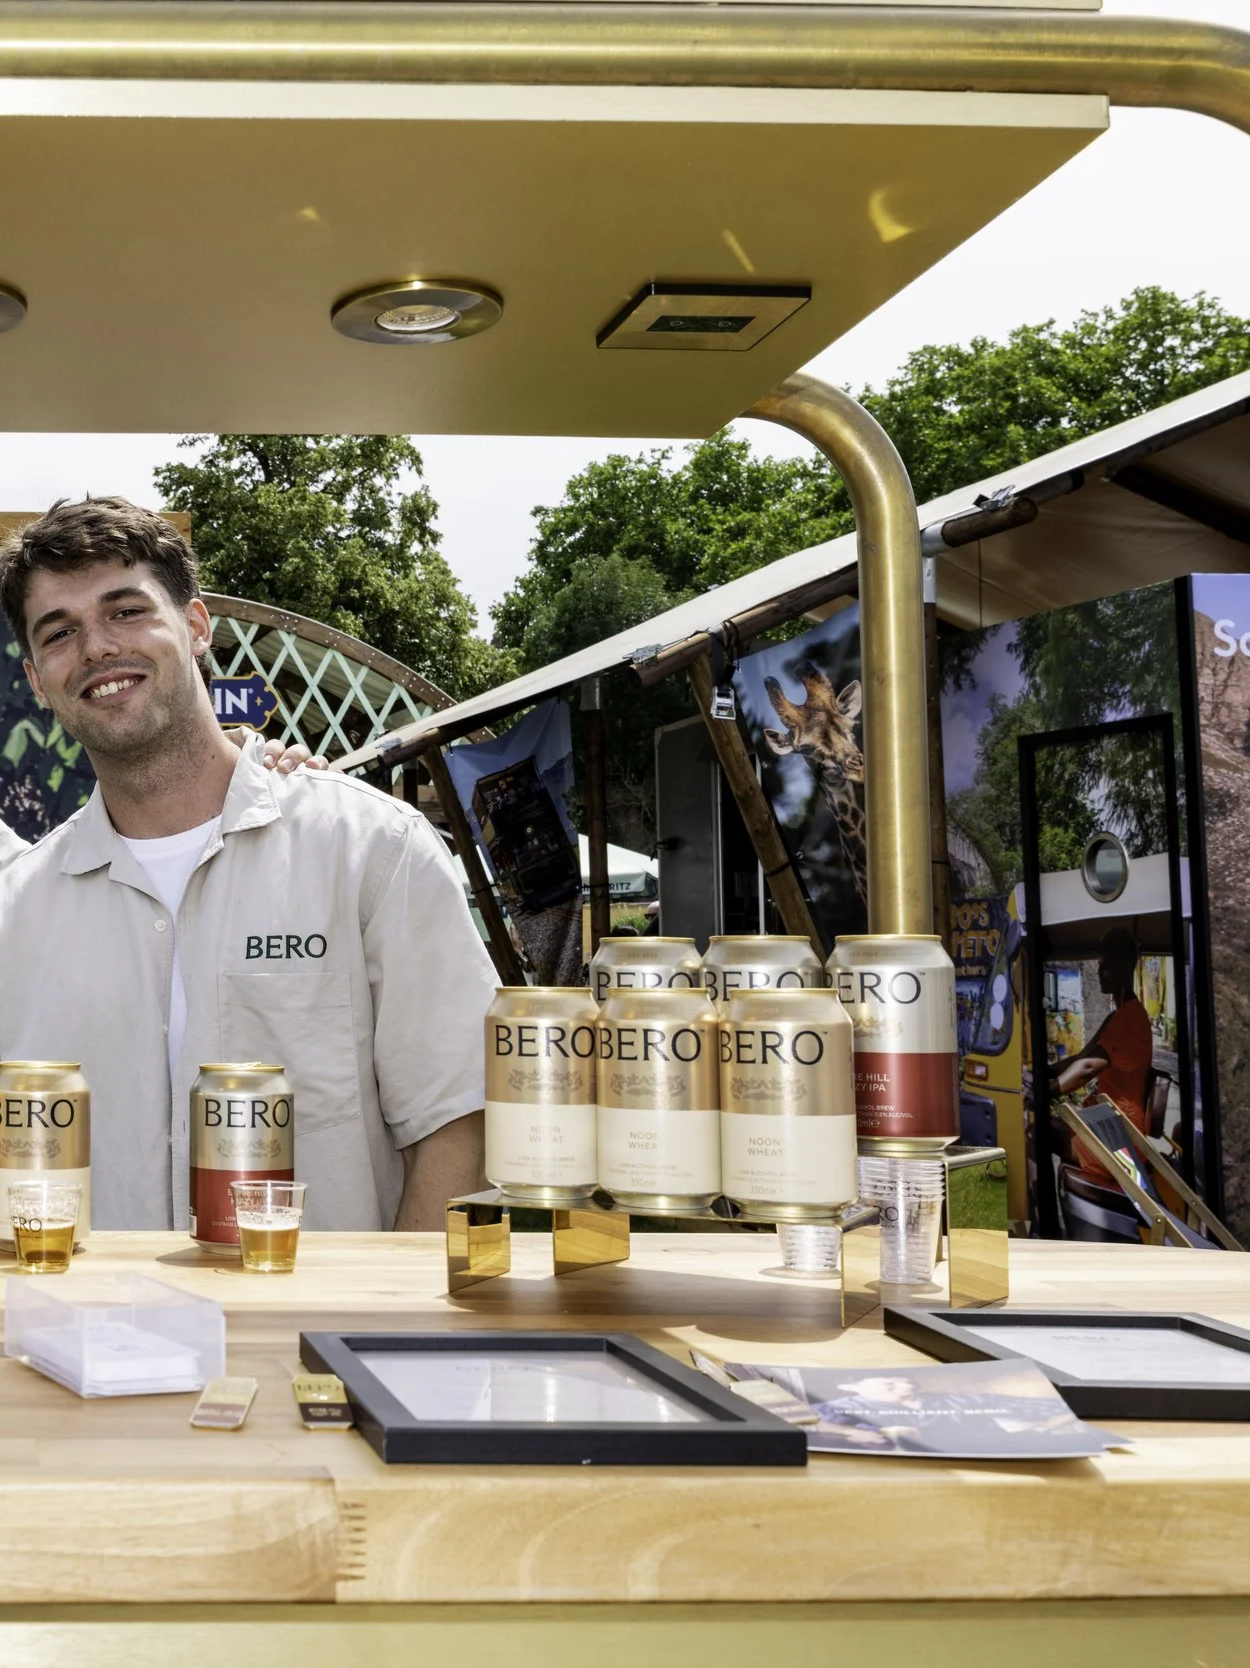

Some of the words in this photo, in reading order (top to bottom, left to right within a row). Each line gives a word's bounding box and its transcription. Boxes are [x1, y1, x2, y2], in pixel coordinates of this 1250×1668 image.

[1213, 618, 1250, 657] S
[245, 933, 327, 959] BERO
[495, 1024, 595, 1058] BERO
[600, 1027, 701, 1062] BERO
[719, 1030, 824, 1065] BERO
[866, 1073, 891, 1082] HILL
[869, 1083, 886, 1092] IPA
[205, 1098, 290, 1128] BERO
[747, 1147, 784, 1156] WHEAT
[748, 1137, 781, 1146] NOON
